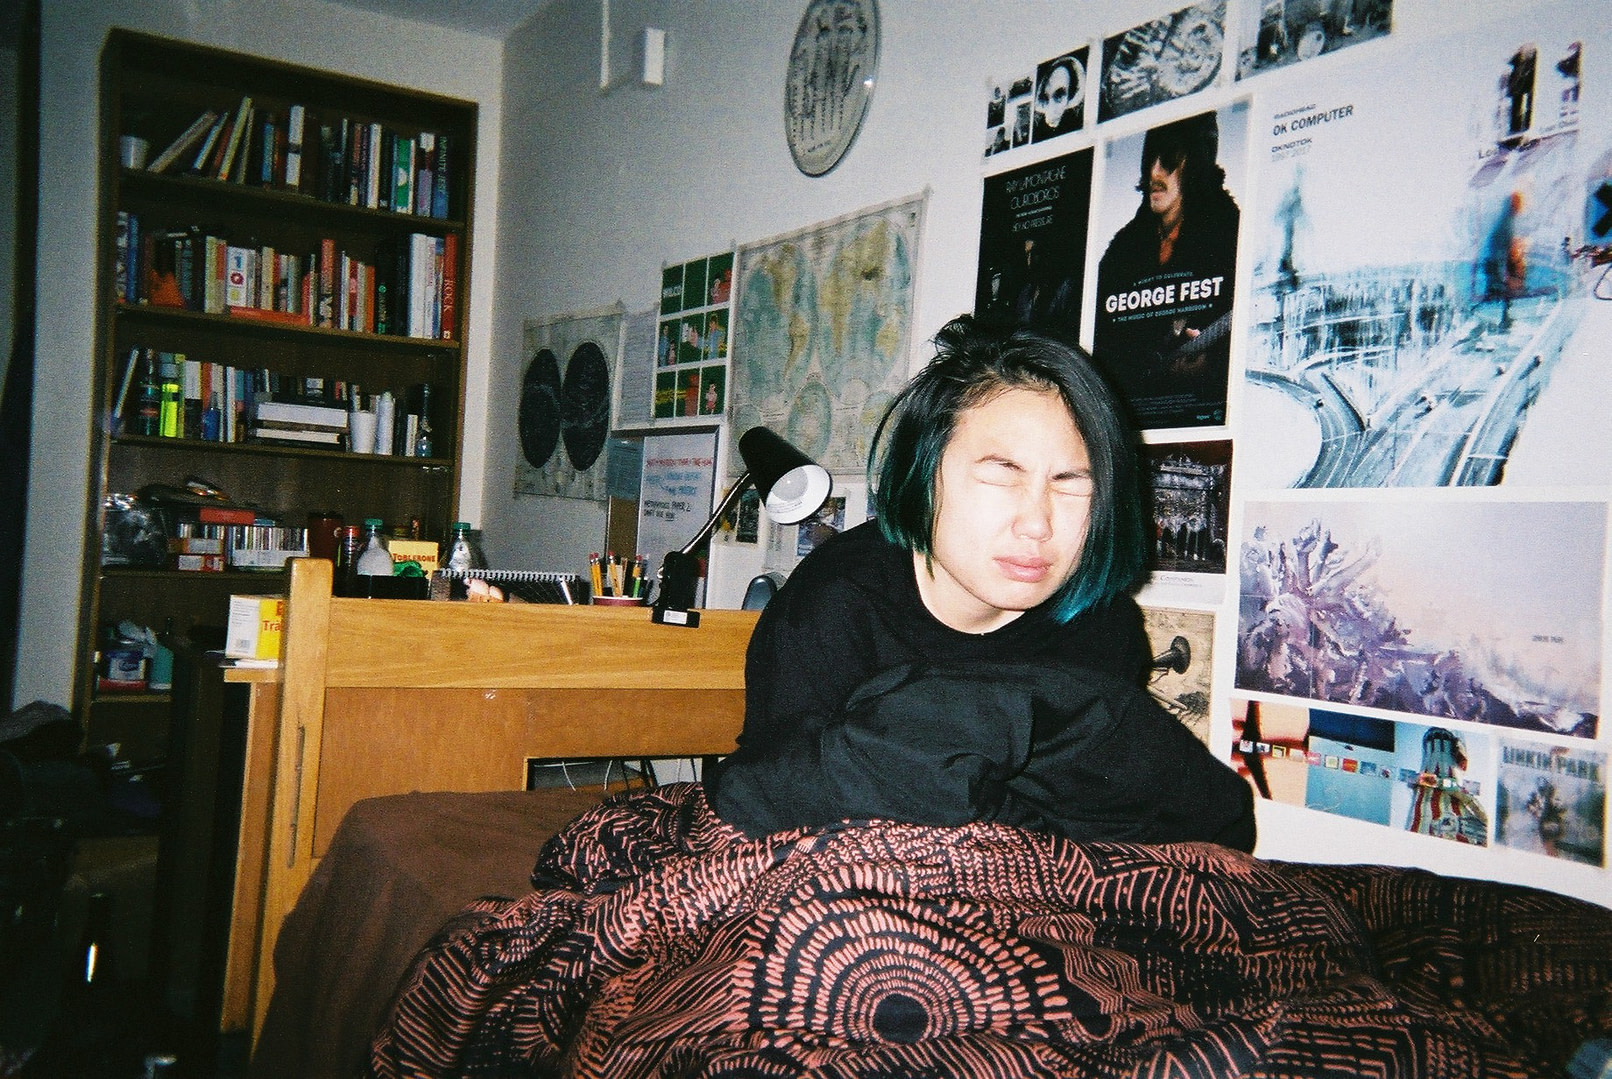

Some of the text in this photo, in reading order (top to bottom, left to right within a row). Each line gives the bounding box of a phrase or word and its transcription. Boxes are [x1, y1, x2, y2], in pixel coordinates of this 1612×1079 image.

[1273, 105, 1354, 136] OK COMPUTER
[441, 279, 456, 313] ROCK
[1105, 276, 1224, 313] GEORGE FEST
[392, 553, 436, 562] TOBLERONE
